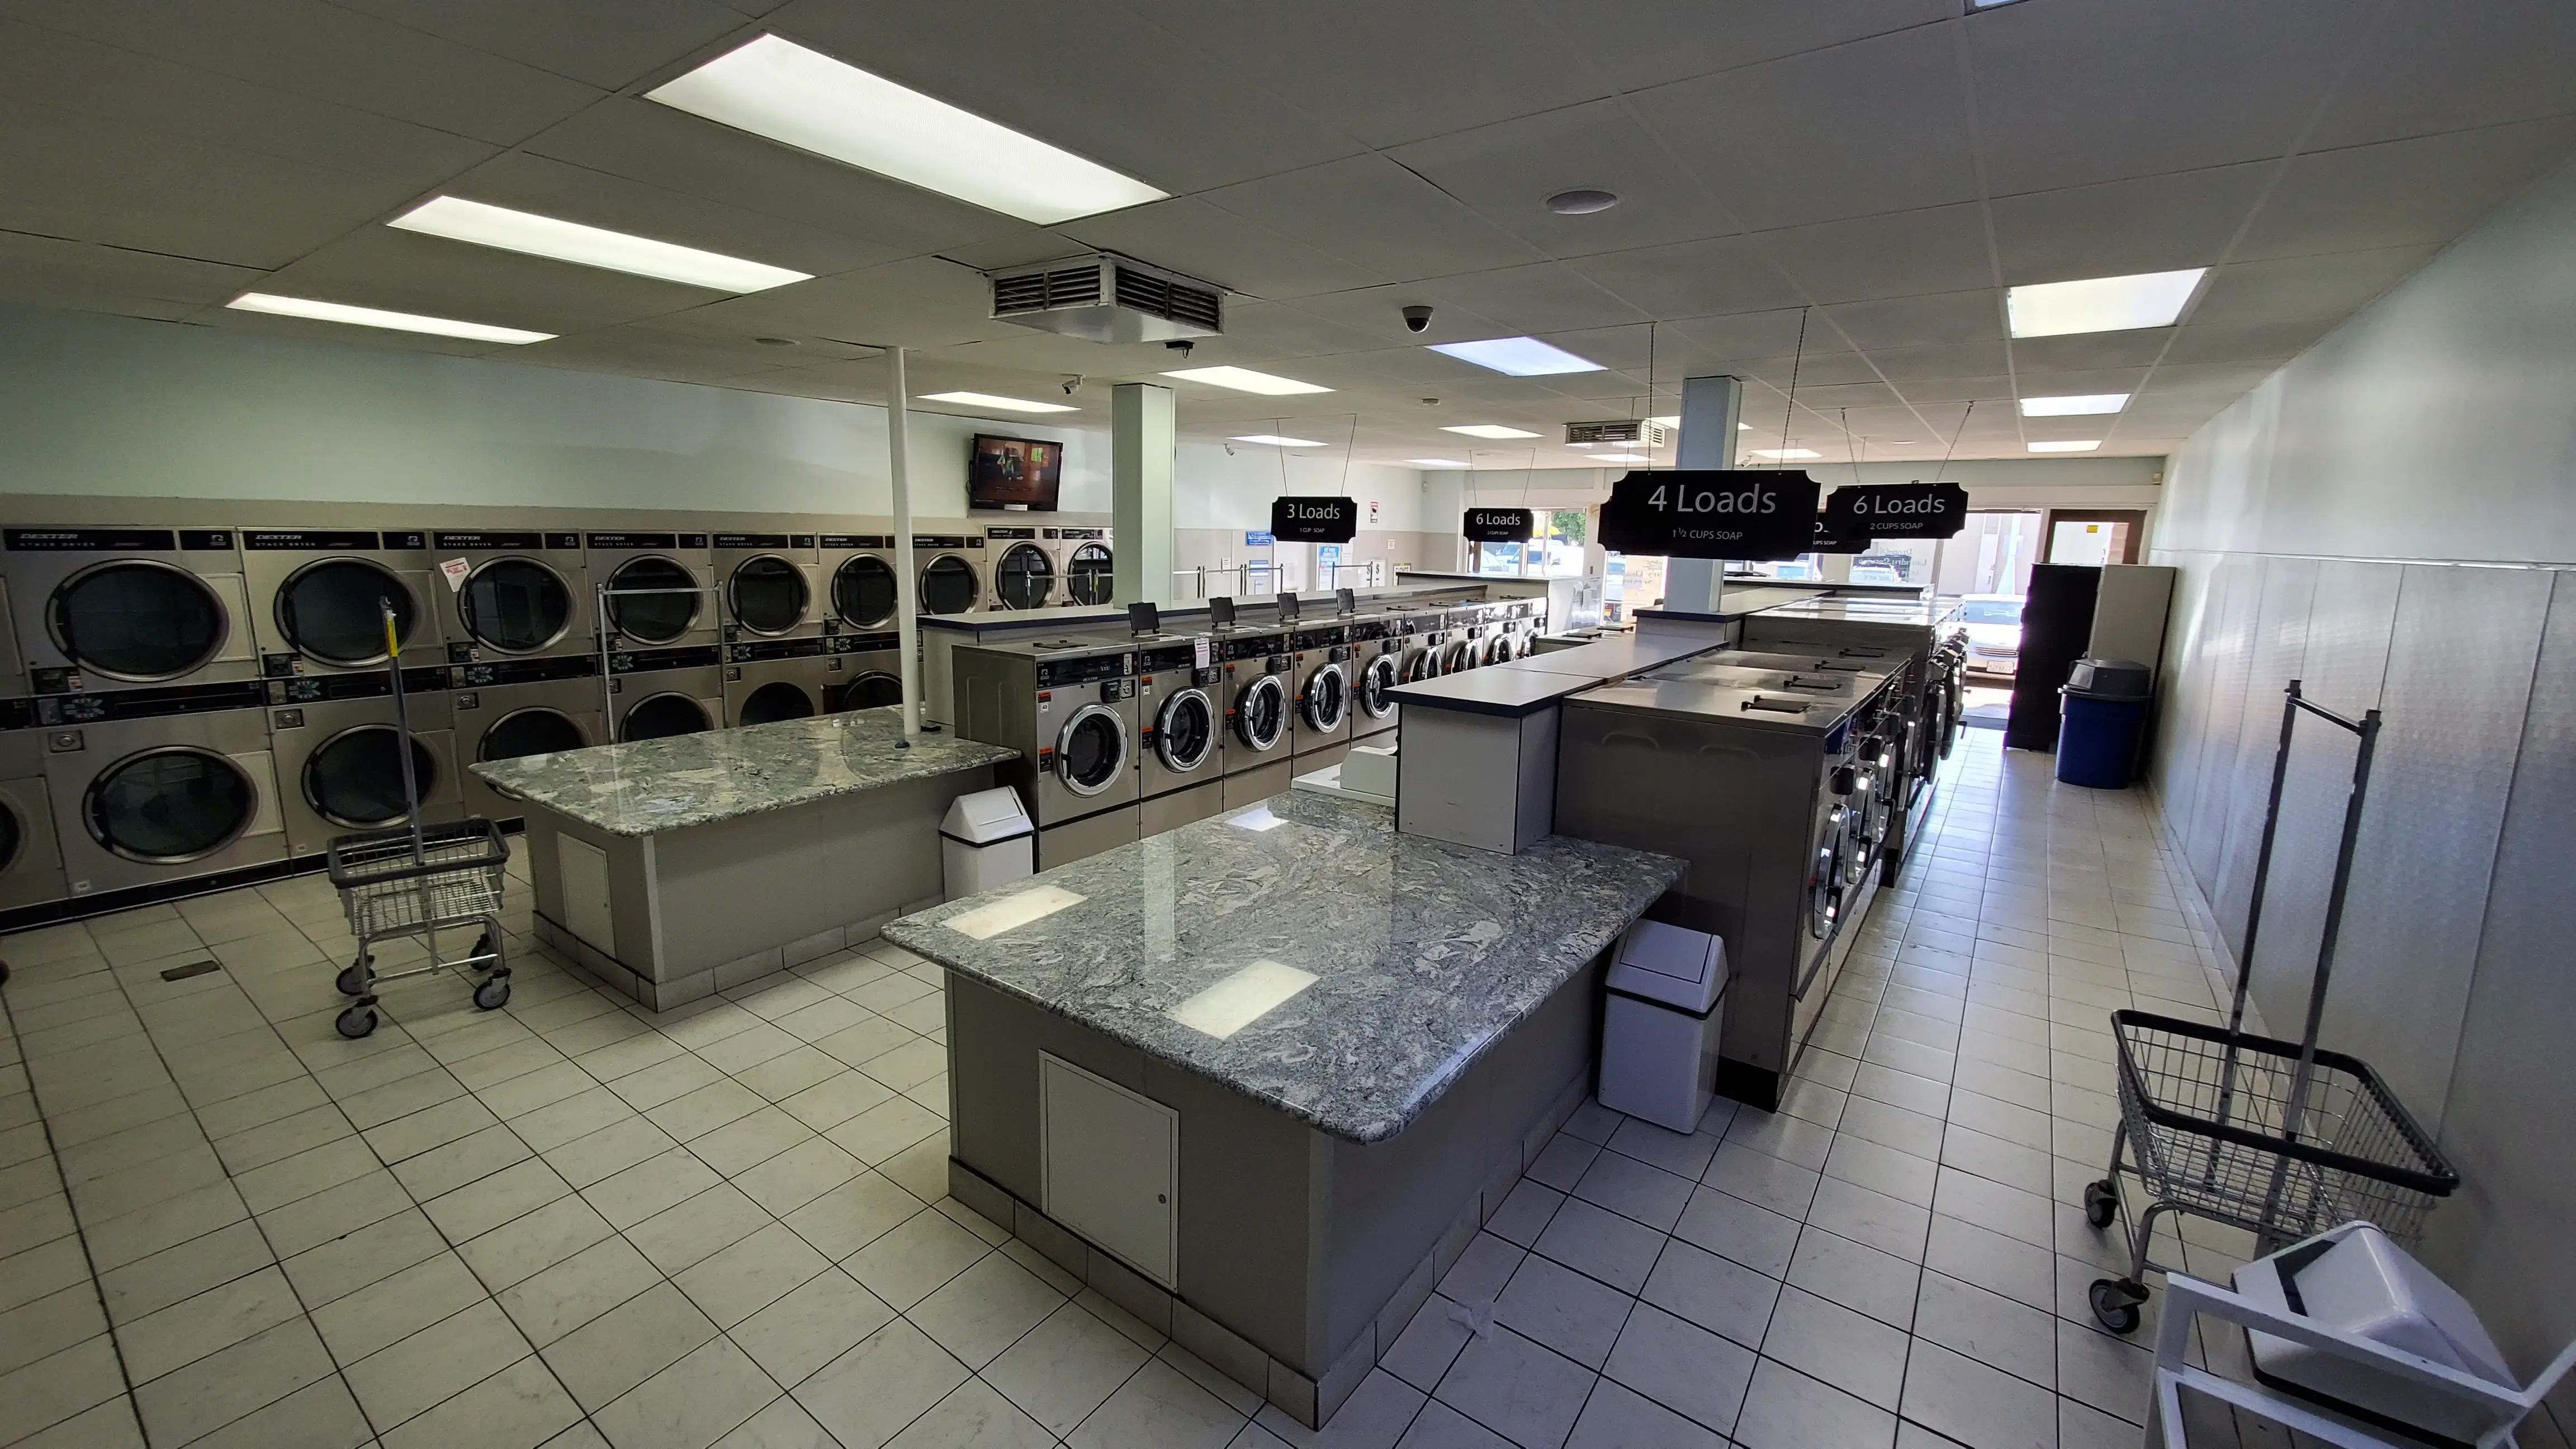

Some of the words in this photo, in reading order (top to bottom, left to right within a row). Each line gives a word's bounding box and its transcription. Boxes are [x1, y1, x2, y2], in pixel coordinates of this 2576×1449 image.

[1648, 485, 1667, 512] 4
[1677, 483, 1777, 514] Loads
[1853, 495, 1868, 514] 6
[1874, 494, 1945, 514] Loads
[1287, 504, 1295, 518] 3
[1299, 503, 1340, 519] Loads
[1476, 513, 1484, 524] 6
[1486, 513, 1521, 525] Loads
[1689, 530, 1714, 539] CUPS
[1716, 531, 1743, 541] SOAP
